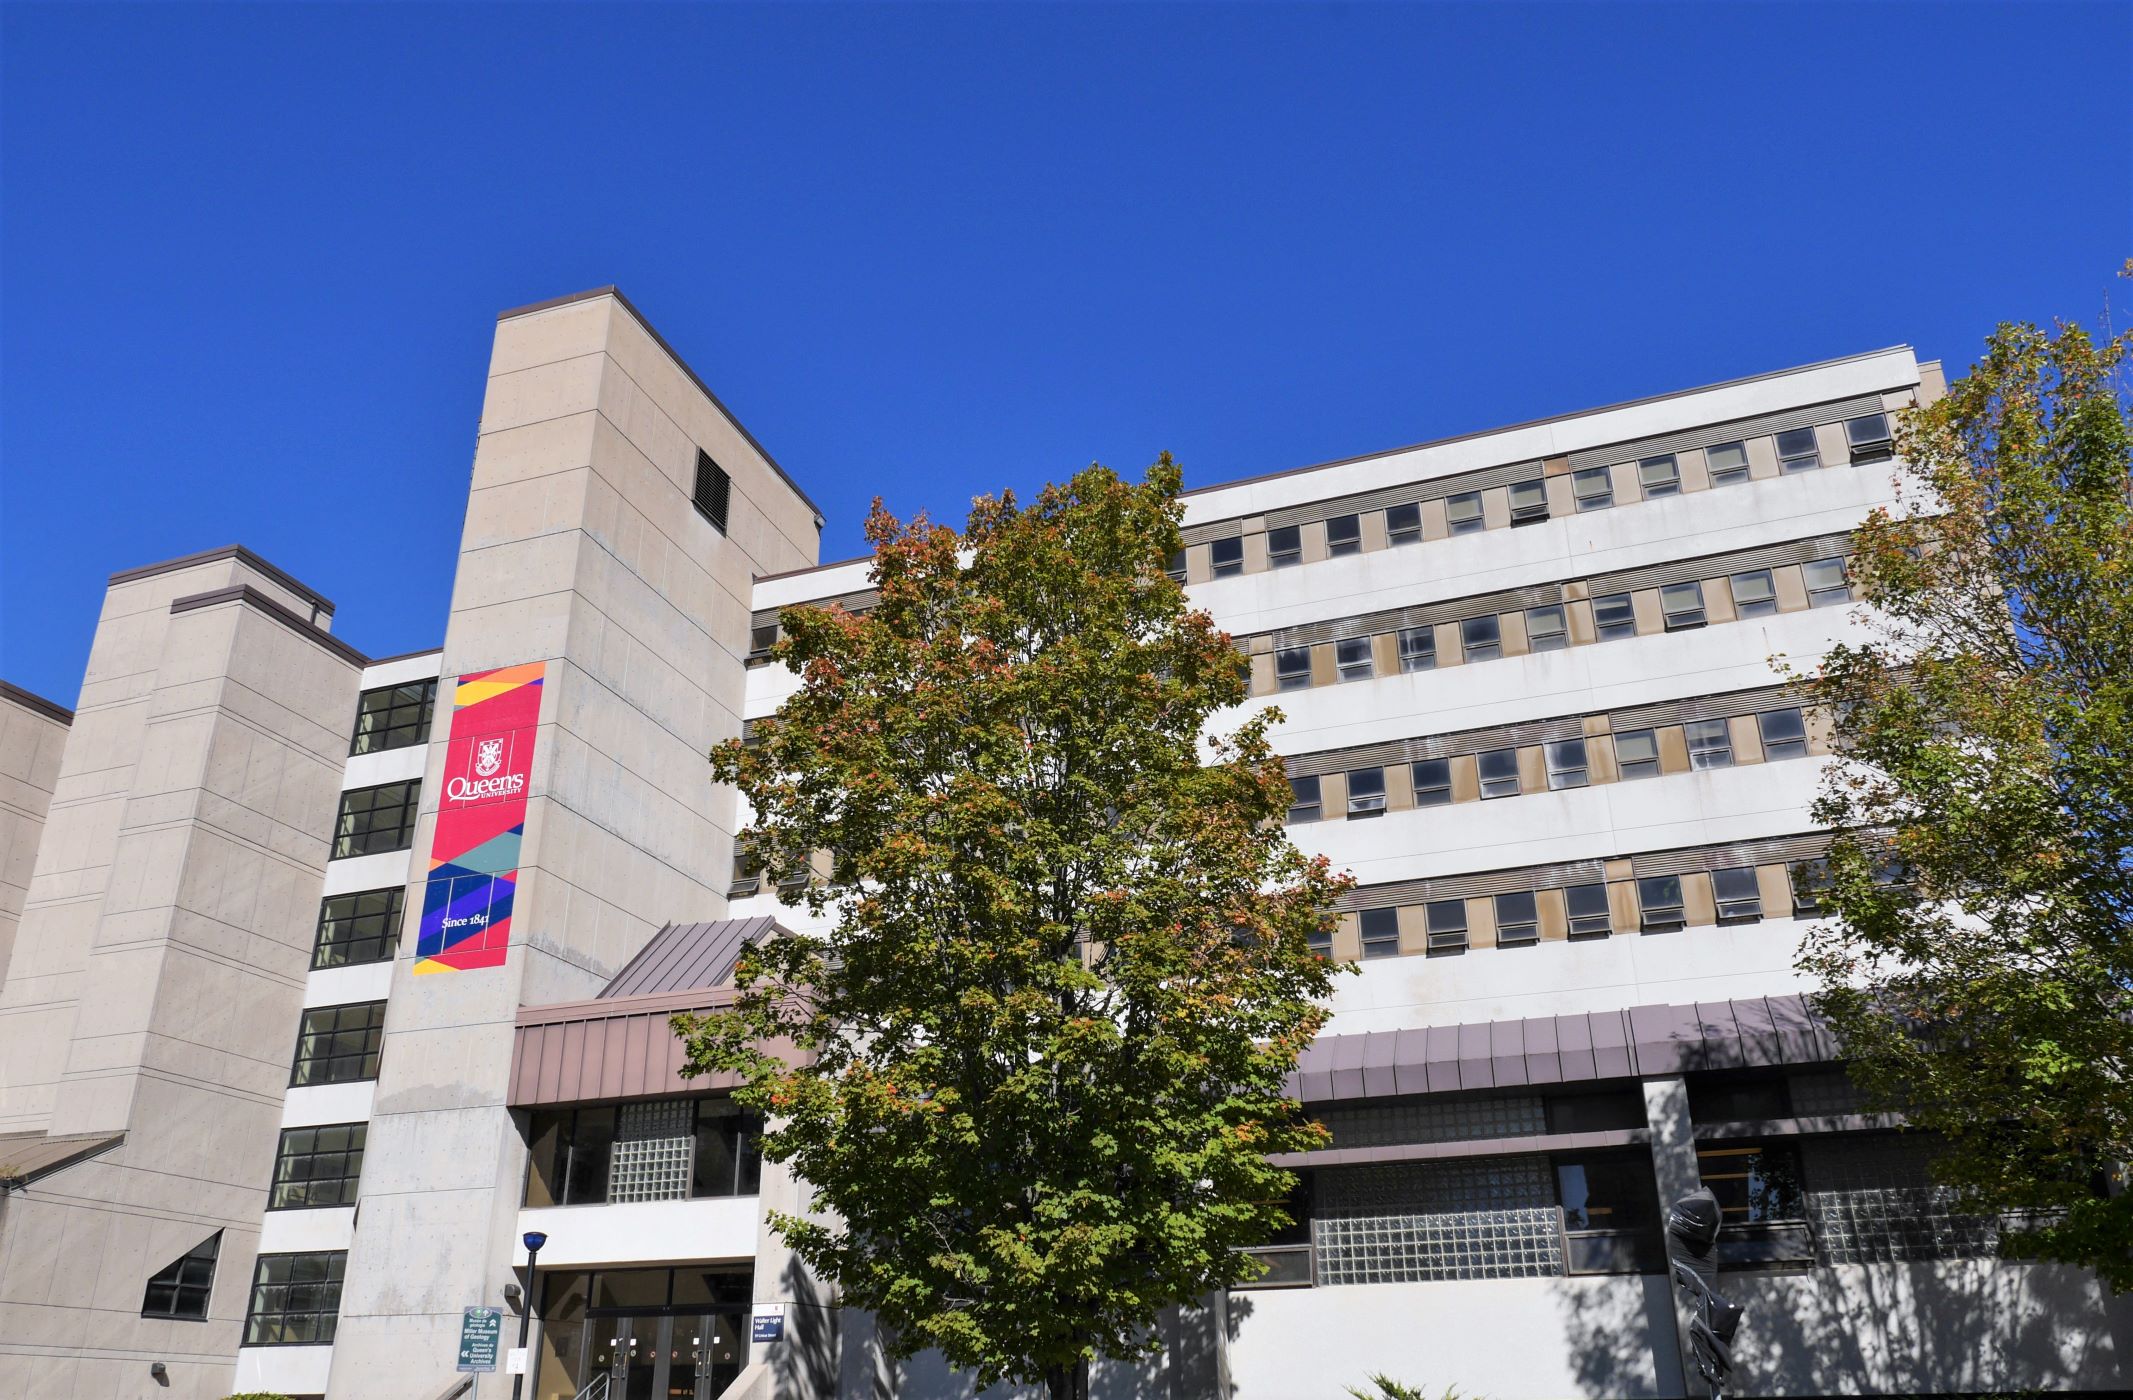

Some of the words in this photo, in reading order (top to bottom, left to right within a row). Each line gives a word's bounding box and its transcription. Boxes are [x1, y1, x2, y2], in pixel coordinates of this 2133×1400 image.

[447, 774, 524, 802] Queen's
[481, 788, 522, 799] UNIVERSITY
[441, 918, 468, 929] Since
[469, 914, 489, 926] 1841
